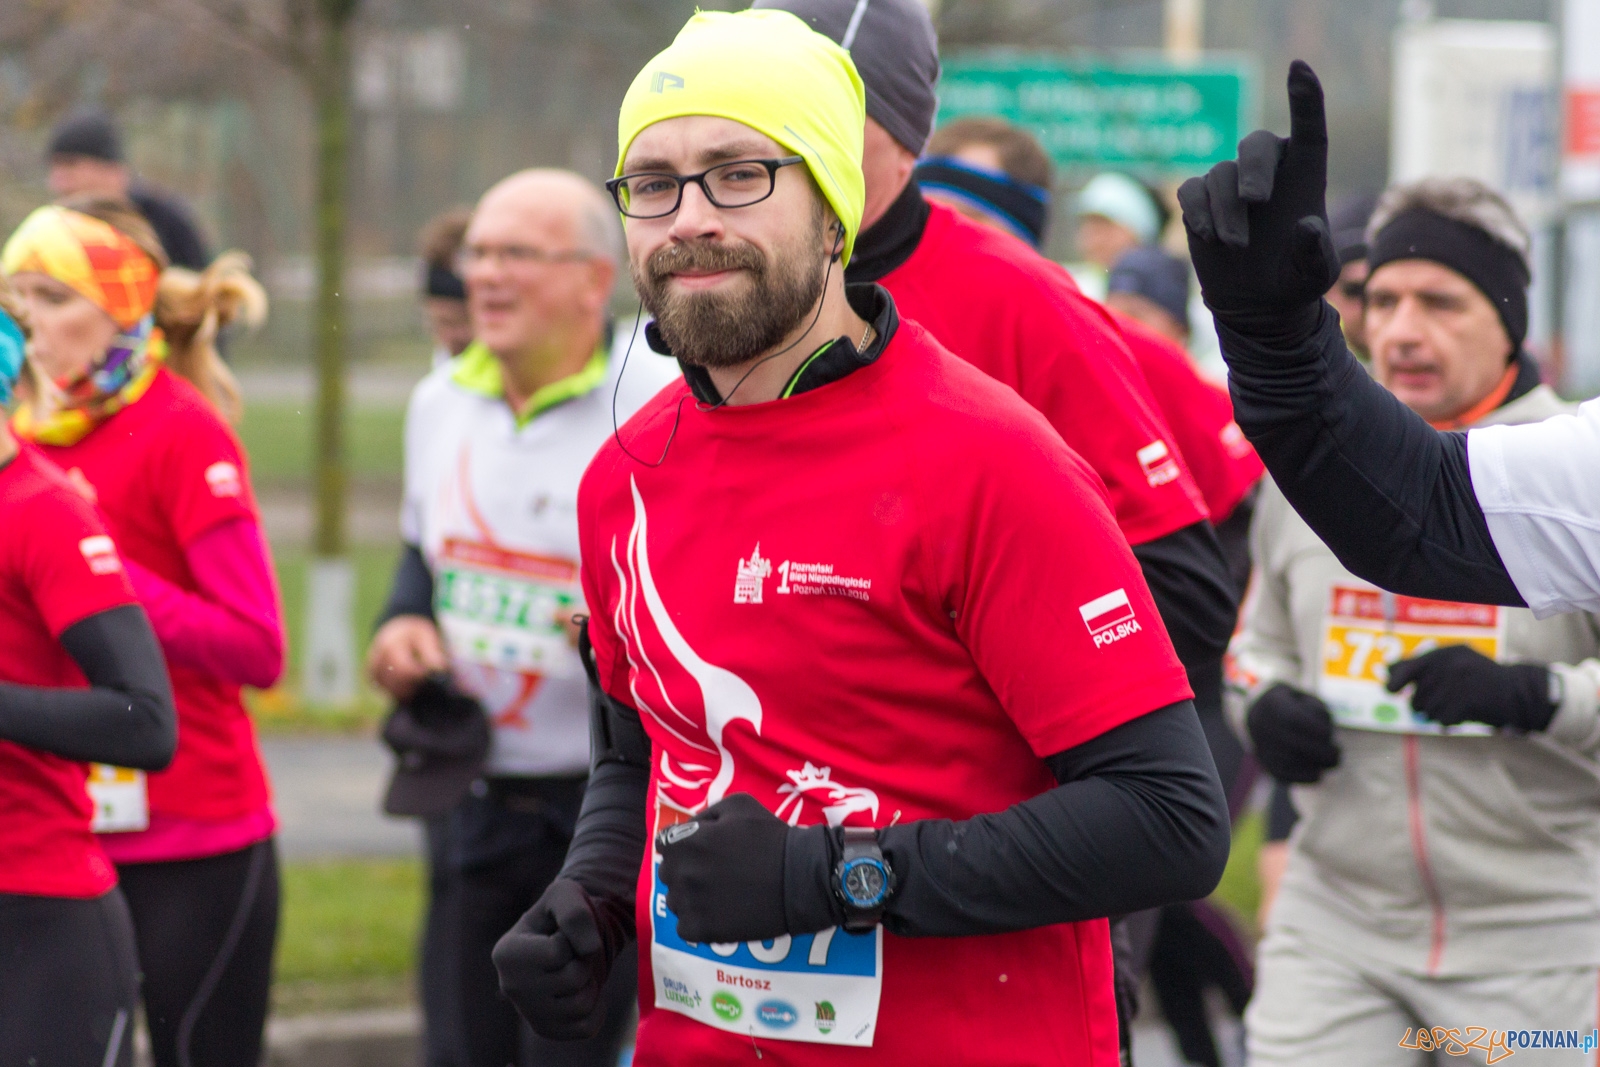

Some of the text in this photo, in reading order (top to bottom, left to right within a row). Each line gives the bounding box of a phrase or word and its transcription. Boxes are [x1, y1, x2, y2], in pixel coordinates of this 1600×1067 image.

[777, 560, 790, 594] 1
[790, 572, 808, 584] Bieg
[791, 562, 833, 574] Poznański
[1093, 619, 1142, 649] POLSKA
[663, 976, 689, 995] GRUPA
[716, 969, 772, 991] Bartosz
[664, 989, 695, 1010] LUXMED
